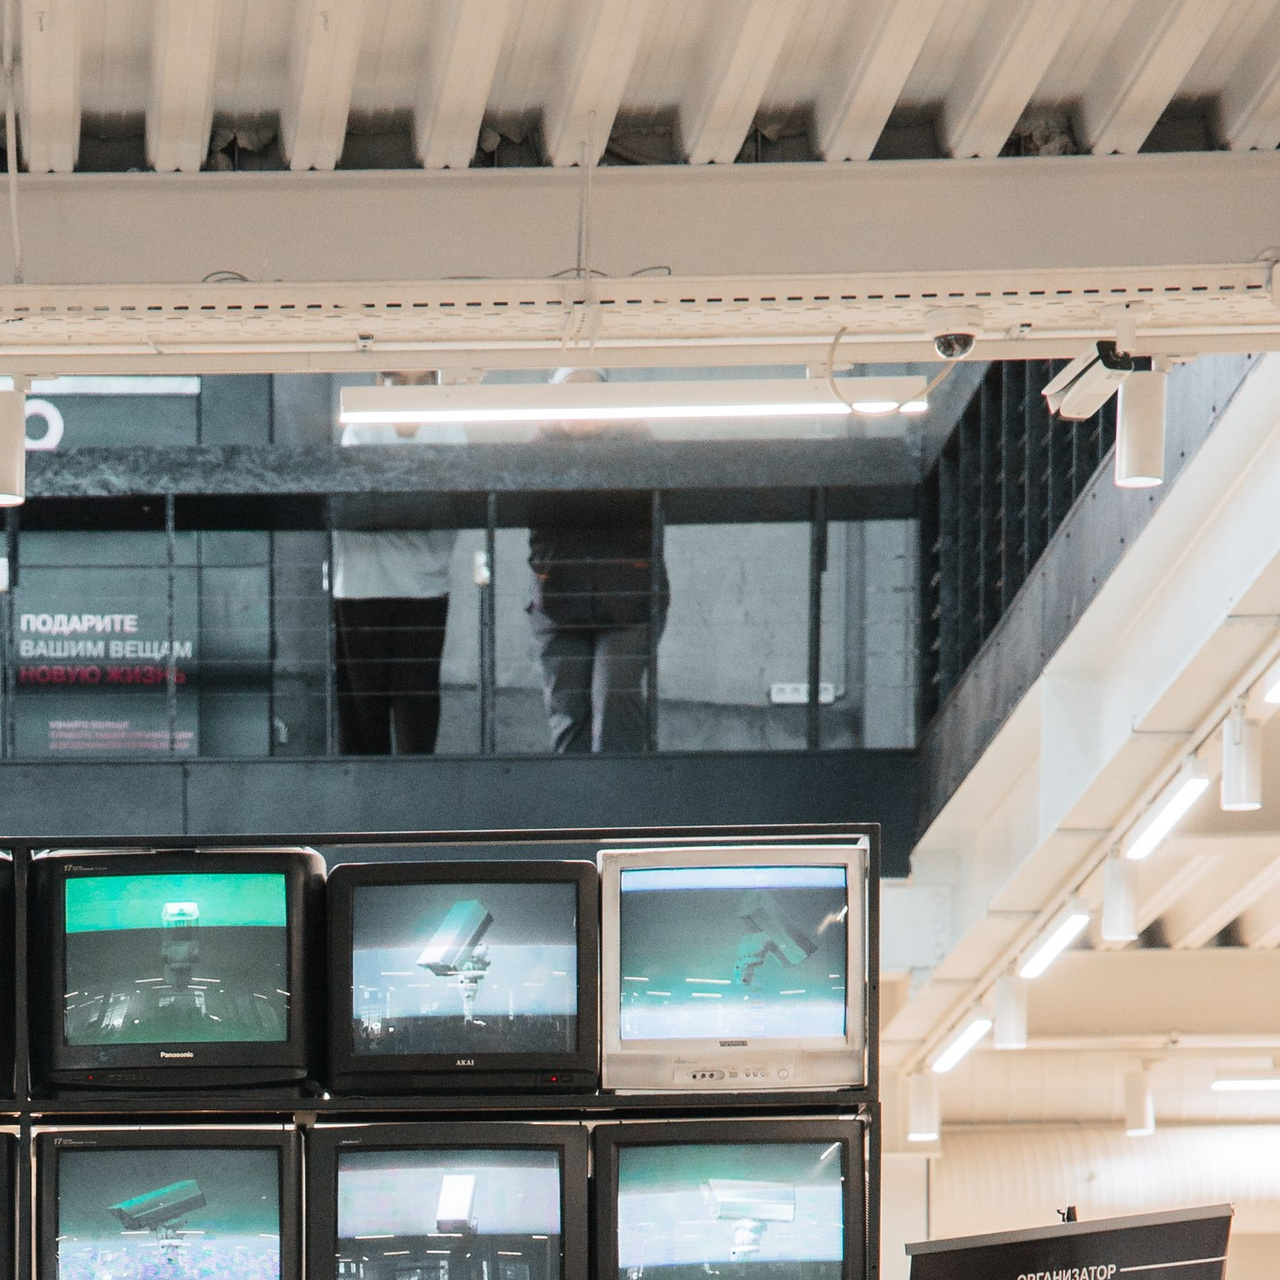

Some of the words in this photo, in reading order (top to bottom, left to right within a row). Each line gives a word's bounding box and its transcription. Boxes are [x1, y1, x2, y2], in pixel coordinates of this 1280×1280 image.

[20, 614, 138, 635] ПОДАРИТЕ
[20, 640, 105, 658] ВАШИМ
[109, 640, 192, 661] ВЕЩАМ
[19, 665, 101, 684] НОВУЮ
